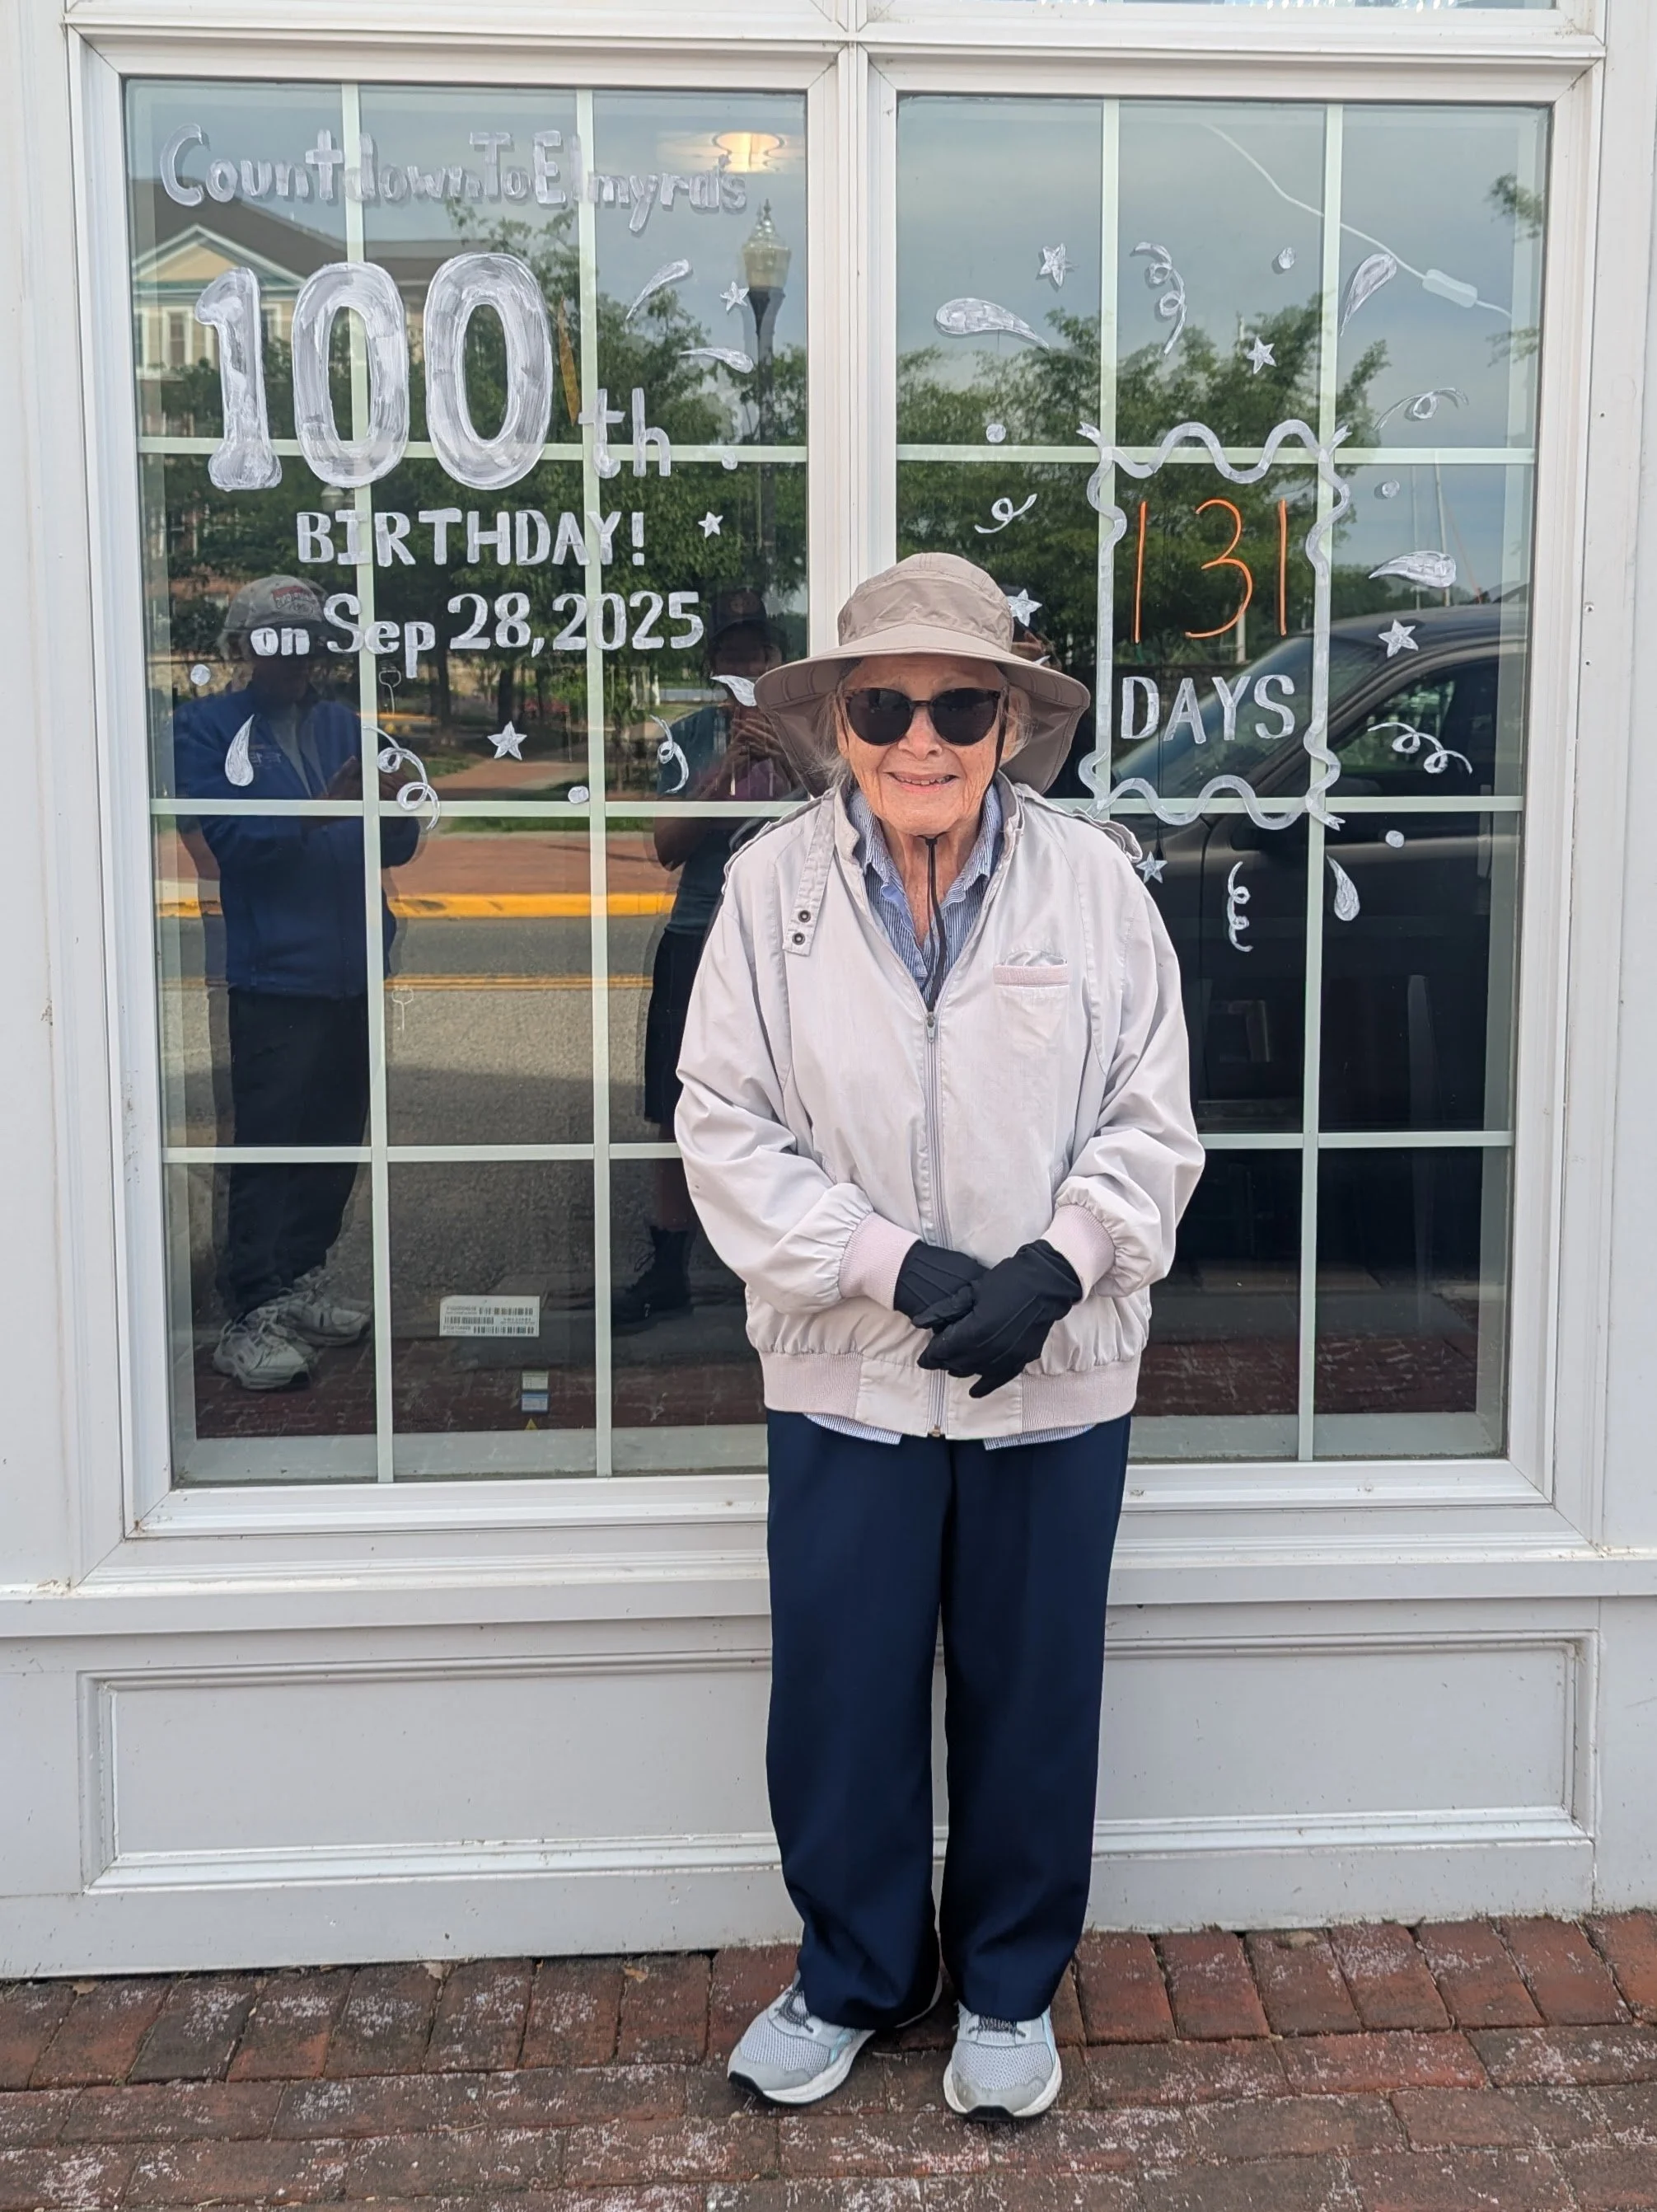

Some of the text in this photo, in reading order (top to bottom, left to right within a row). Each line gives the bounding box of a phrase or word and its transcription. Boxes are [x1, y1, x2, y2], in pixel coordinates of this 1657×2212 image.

[469, 130, 531, 200] To
[296, 507, 645, 569] BIRTHDAY!
[1133, 497, 1288, 644] 131
[249, 626, 311, 657] on
[322, 592, 437, 680] Sep
[1120, 673, 1296, 744] DAYS
